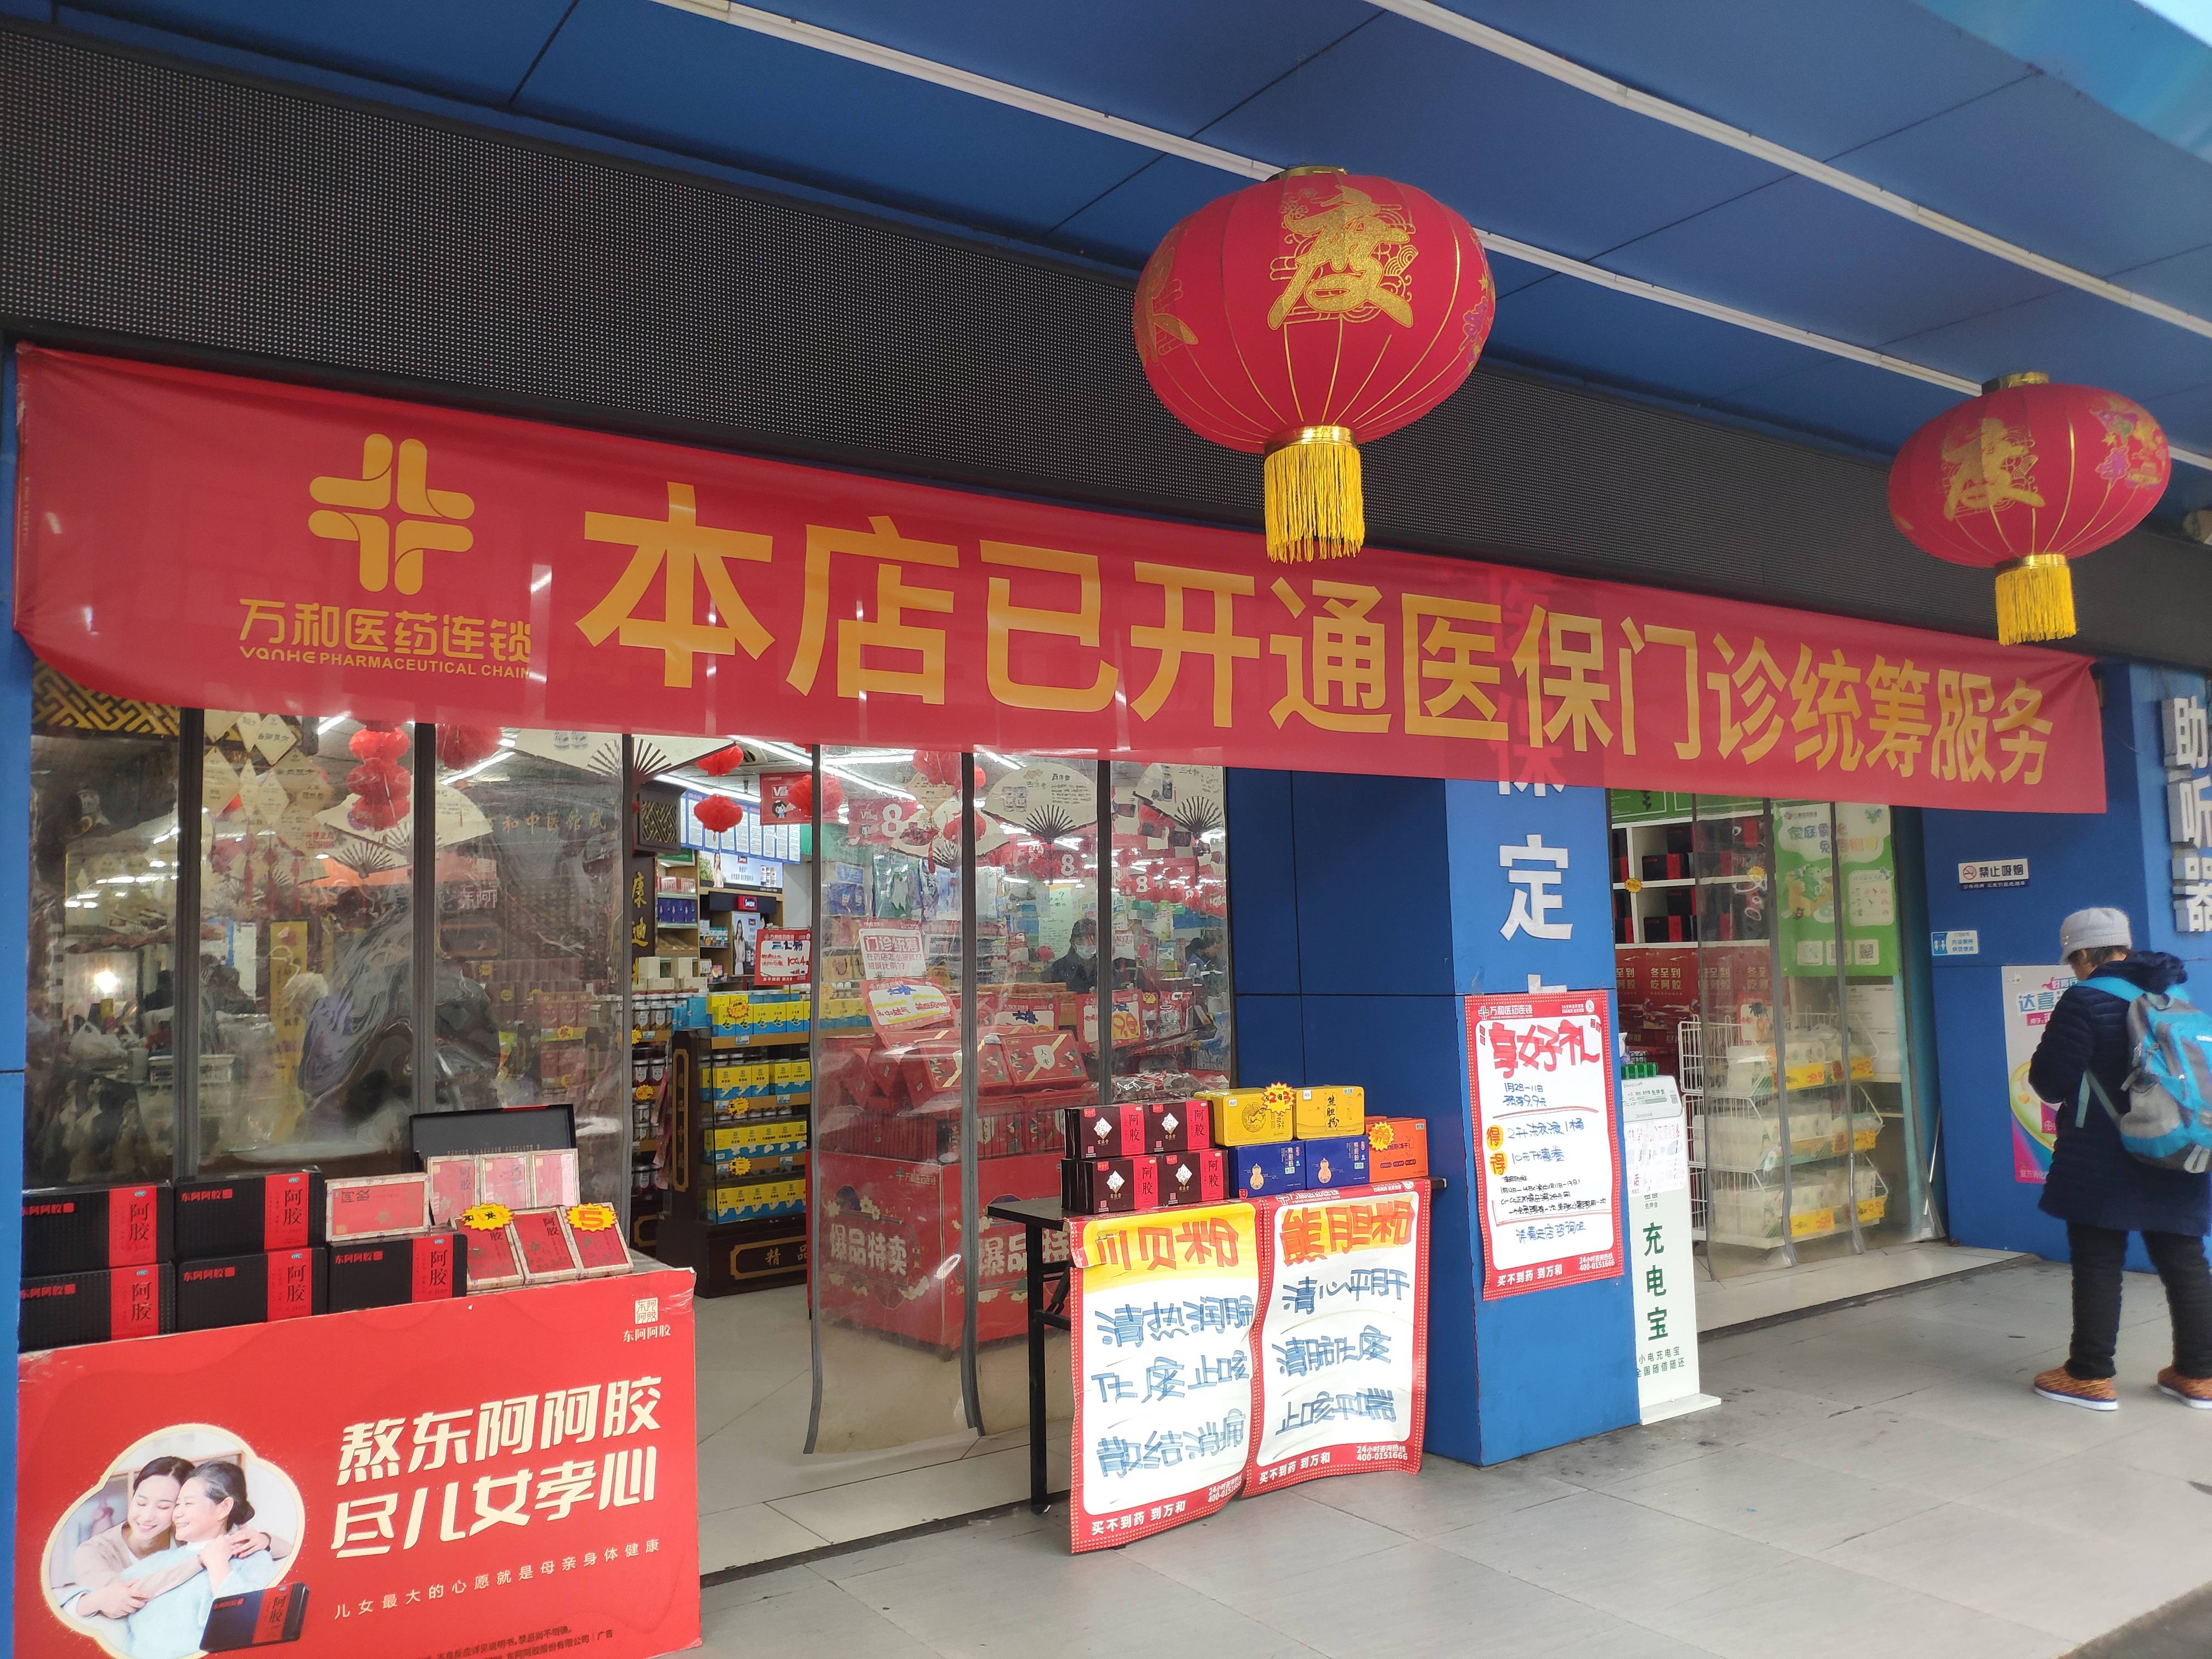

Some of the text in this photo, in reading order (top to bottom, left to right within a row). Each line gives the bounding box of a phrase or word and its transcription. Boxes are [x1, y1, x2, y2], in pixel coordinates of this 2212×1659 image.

[239, 599, 531, 663] 万和医药连锁
[575, 482, 2054, 786] 本店已开通医保门诊统筹服务
[319, 653, 476, 675] PHARMACEUTICAL
[1979, 864, 2024, 878] 禁止吸烟
[866, 936, 919, 952] 门诊统筹
[1651, 967, 1681, 978] 冬至到
[1650, 979, 1681, 990] 吃阿胶
[1489, 1005, 1533, 1015] 万和医药连锁
[1128, 1114, 1141, 1142] 阿胶
[1193, 1108, 1206, 1137] 阿胶
[1142, 1167, 1155, 1196] 阿胶
[1207, 1159, 1220, 1188] 阿胶
[181, 1188, 222, 1201] 东阿阿胶
[341, 1189, 370, 1204] 阿胶
[283, 1188, 303, 1226] 阿胶
[129, 1203, 149, 1242] 阿胶
[543, 1217, 560, 1237] 阿胶
[578, 1210, 605, 1228] 5
[335, 1251, 374, 1265] 东阿阿胶
[765, 1246, 807, 1267] 精品
[830, 1223, 907, 1276] 爆品特卖
[1578, 1251, 1613, 1265] 24小时咨询热线
[183, 1267, 224, 1282] 东阿阿胶
[429, 1249, 448, 1286] 阿胶
[1496, 1263, 1563, 1287] 买不到药 到万和
[1578, 1260, 1615, 1272] 400-0151666
[287, 1264, 306, 1302] 阿胶
[1282, 1268, 1410, 1315] 清心平肝
[1643, 1222, 1669, 1341] 充电宝
[131, 1281, 152, 1322] 阿胶
[623, 1324, 672, 1344] 东阿阿胶
[1639, 1346, 1680, 1365] 小电充电宝
[336, 1375, 662, 1486] 熬东阿阿胶
[1356, 1444, 1407, 1454] 24小时咨询热线
[1356, 1451, 1408, 1462] 400-0151666
[1259, 1452, 1331, 1485] 买不到药 到万和
[330, 1446, 657, 1559] 尽儿女孝心
[1091, 1500, 1187, 1536] 买不到药 到万和
[334, 1538, 660, 1621] 儿女最大的心愿就是母亲身体健康
[597, 1629, 613, 1640] 广告
